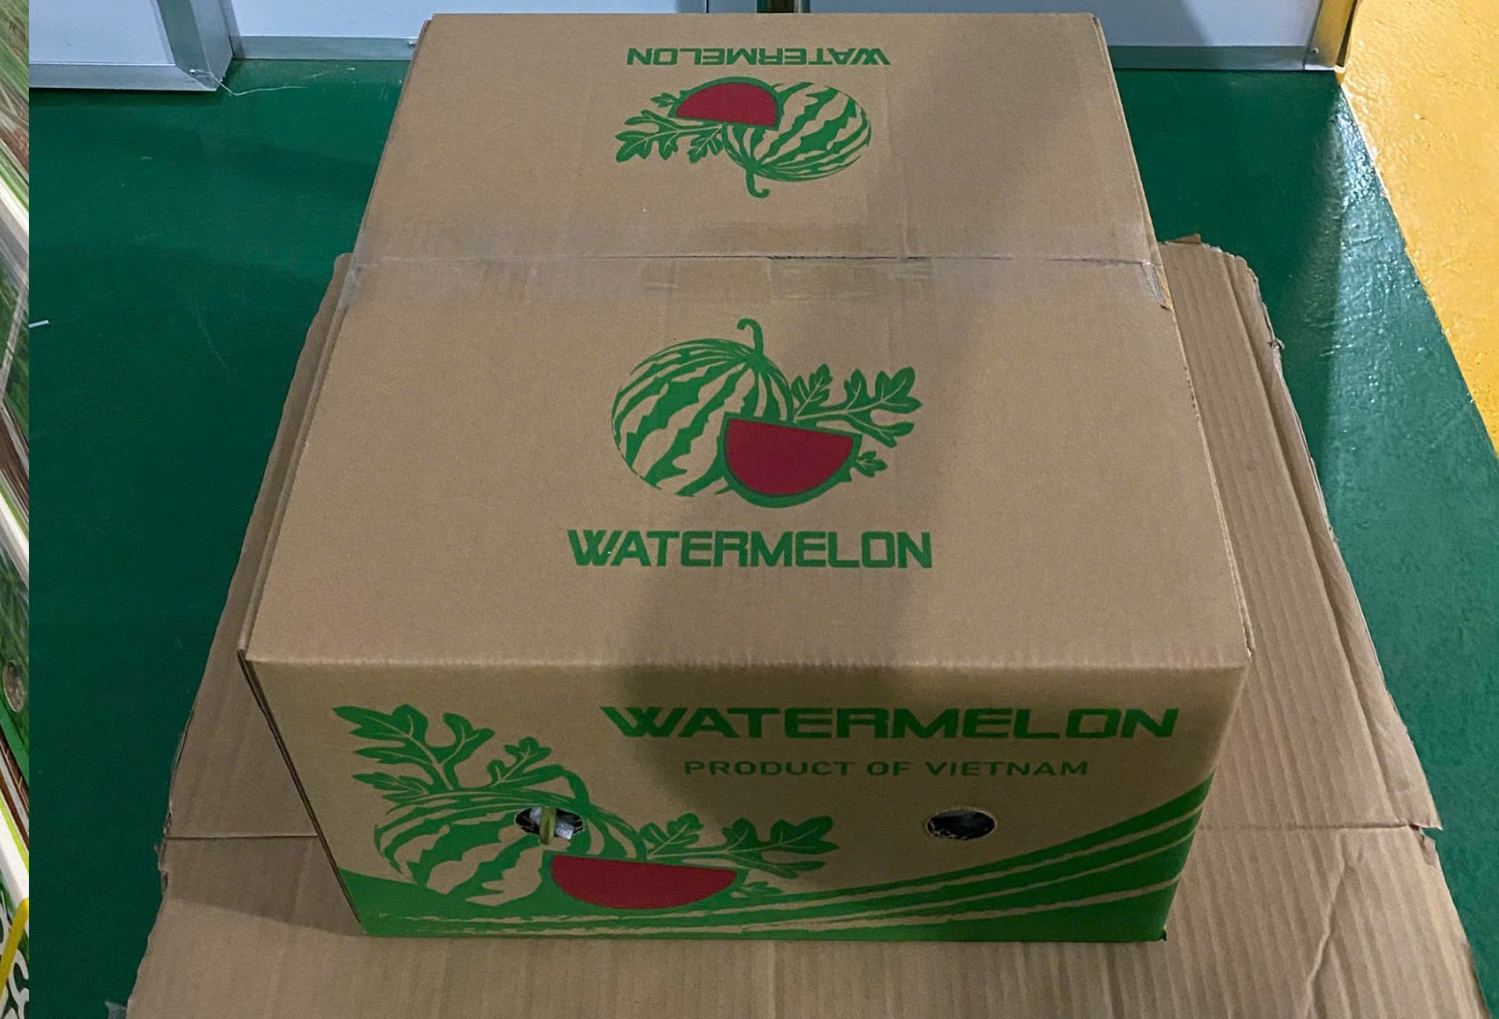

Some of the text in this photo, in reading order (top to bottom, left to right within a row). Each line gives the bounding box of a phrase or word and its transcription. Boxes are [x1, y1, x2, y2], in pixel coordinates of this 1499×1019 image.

[626, 48, 891, 66] WATERMELON
[567, 529, 933, 569] WATERMELON
[599, 706, 1180, 739] WATERMELON
[684, 760, 1089, 776] PRODUCT OF VIETNAM
